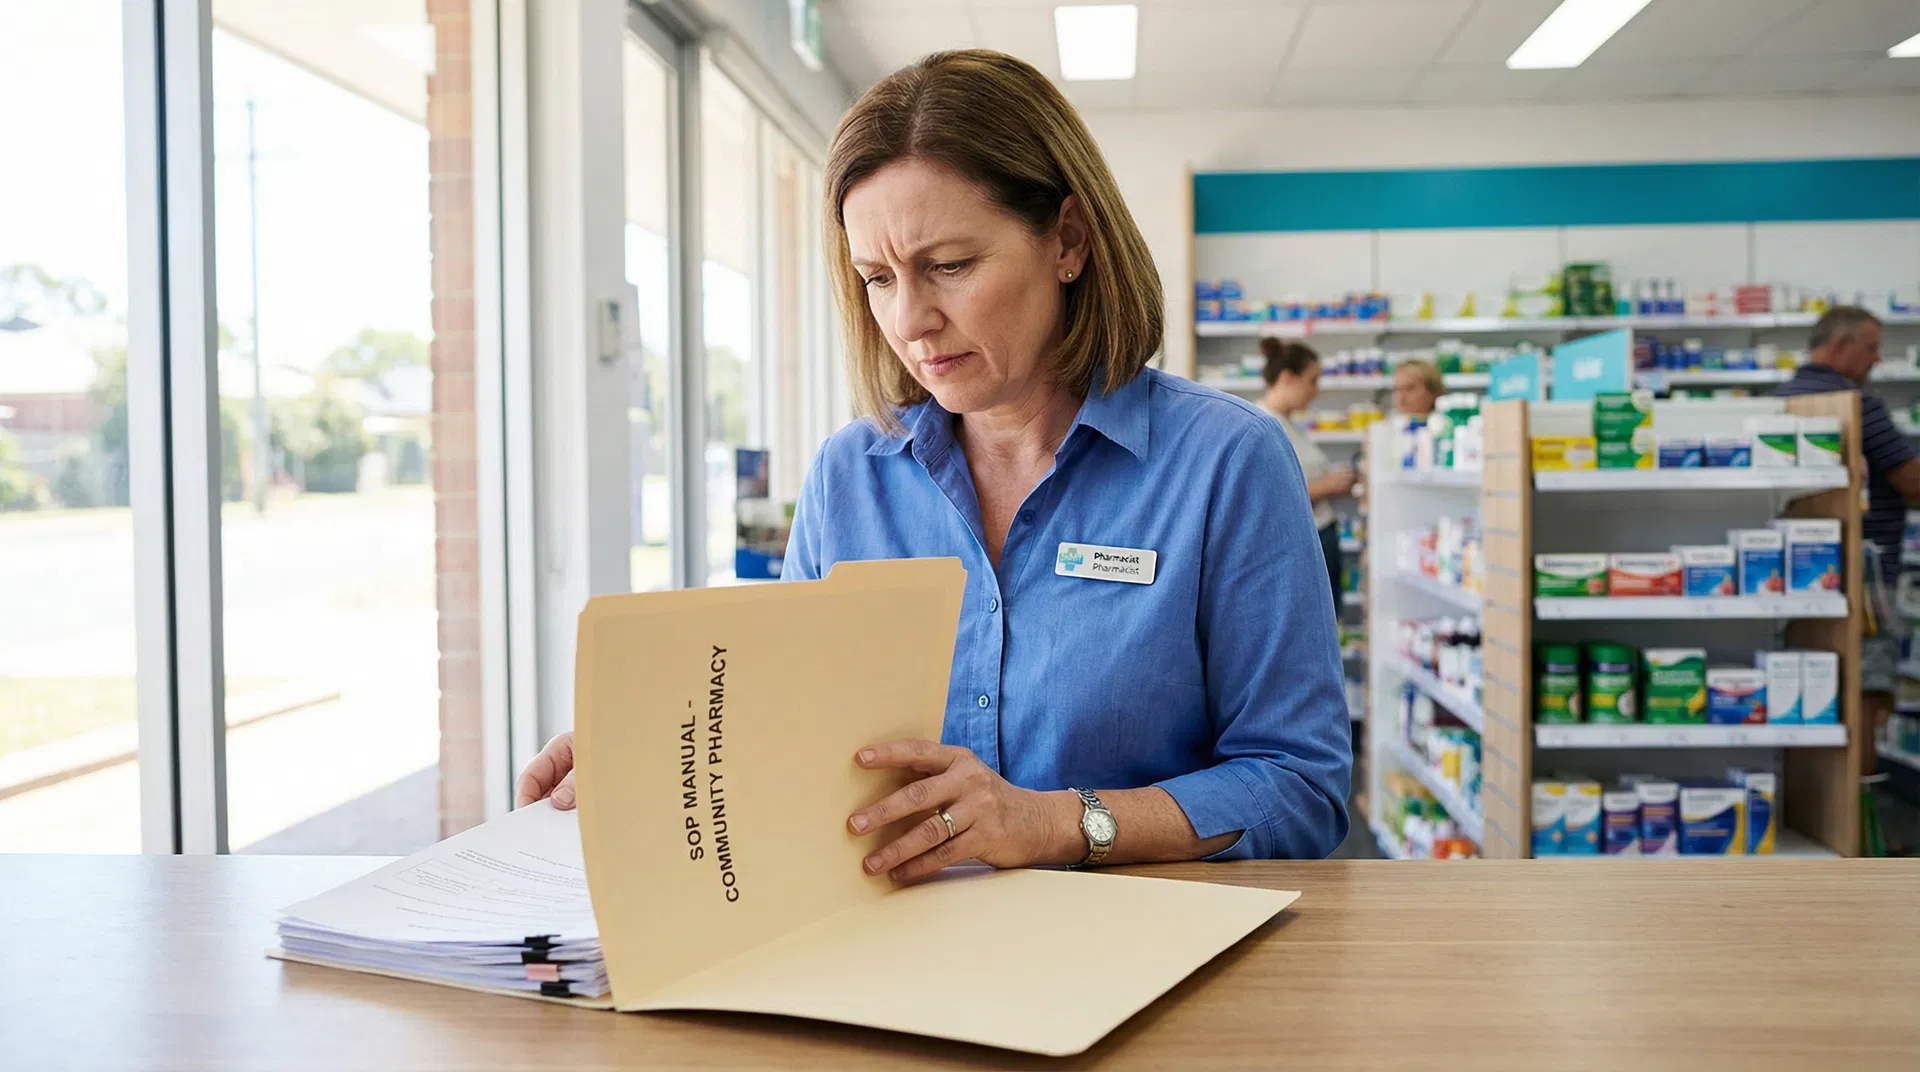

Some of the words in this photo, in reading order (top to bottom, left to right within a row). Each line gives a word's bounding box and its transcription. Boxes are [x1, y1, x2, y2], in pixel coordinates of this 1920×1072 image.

[708, 645, 728, 765] PHARMACY
[680, 715, 698, 809] MANUAL
[685, 816, 704, 861] SOP
[709, 772, 740, 903] COMMUNITY
